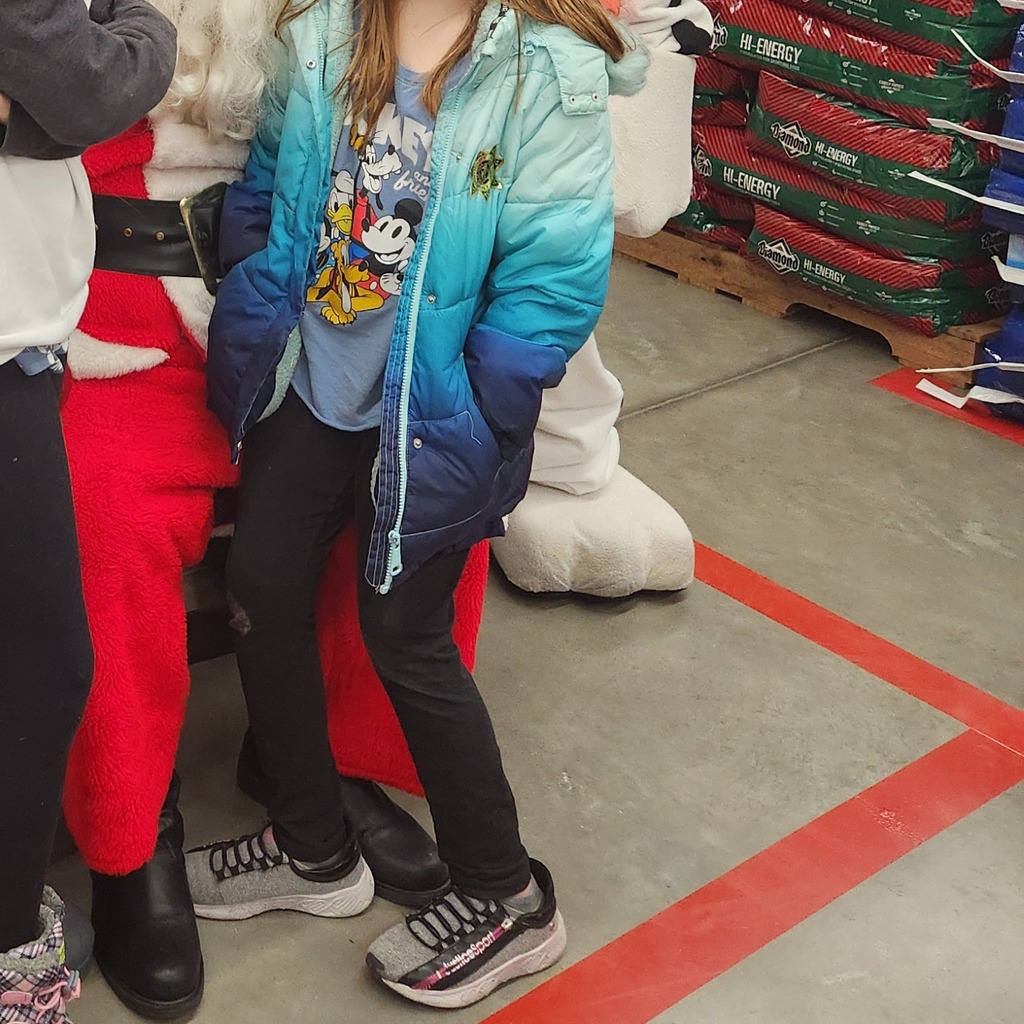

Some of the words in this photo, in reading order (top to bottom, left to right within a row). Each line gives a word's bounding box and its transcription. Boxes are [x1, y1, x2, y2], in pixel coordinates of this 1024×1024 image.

[739, 32, 803, 65] HI-ENERGY
[772, 123, 811, 154] Diamond
[815, 141, 858, 167] HI-ENERGY
[393, 169, 430, 202] frie
[723, 166, 781, 200] HI-ENERGY
[758, 241, 799, 270] Diamond
[803, 258, 846, 284] HI-ENERGY
